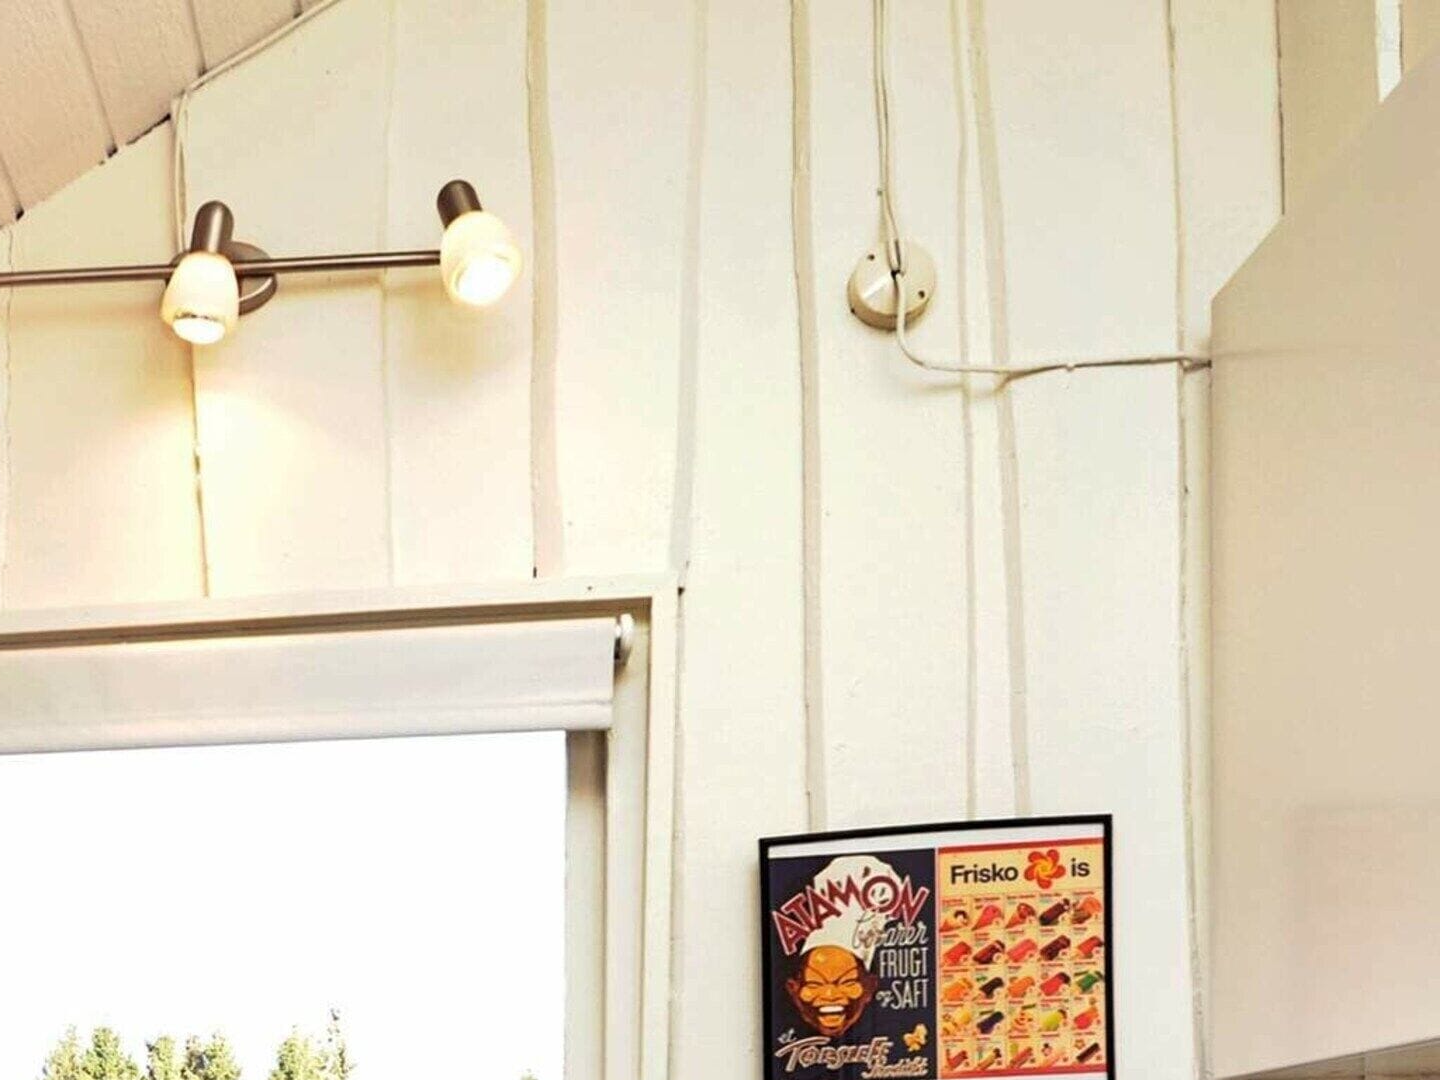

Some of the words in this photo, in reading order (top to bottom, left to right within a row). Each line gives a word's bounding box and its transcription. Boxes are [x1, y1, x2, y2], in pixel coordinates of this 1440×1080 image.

[950, 863, 1019, 885] Frisko
[1070, 857, 1091, 878] is
[878, 947, 929, 979] FRUGT
[890, 979, 929, 1010] SAFT
